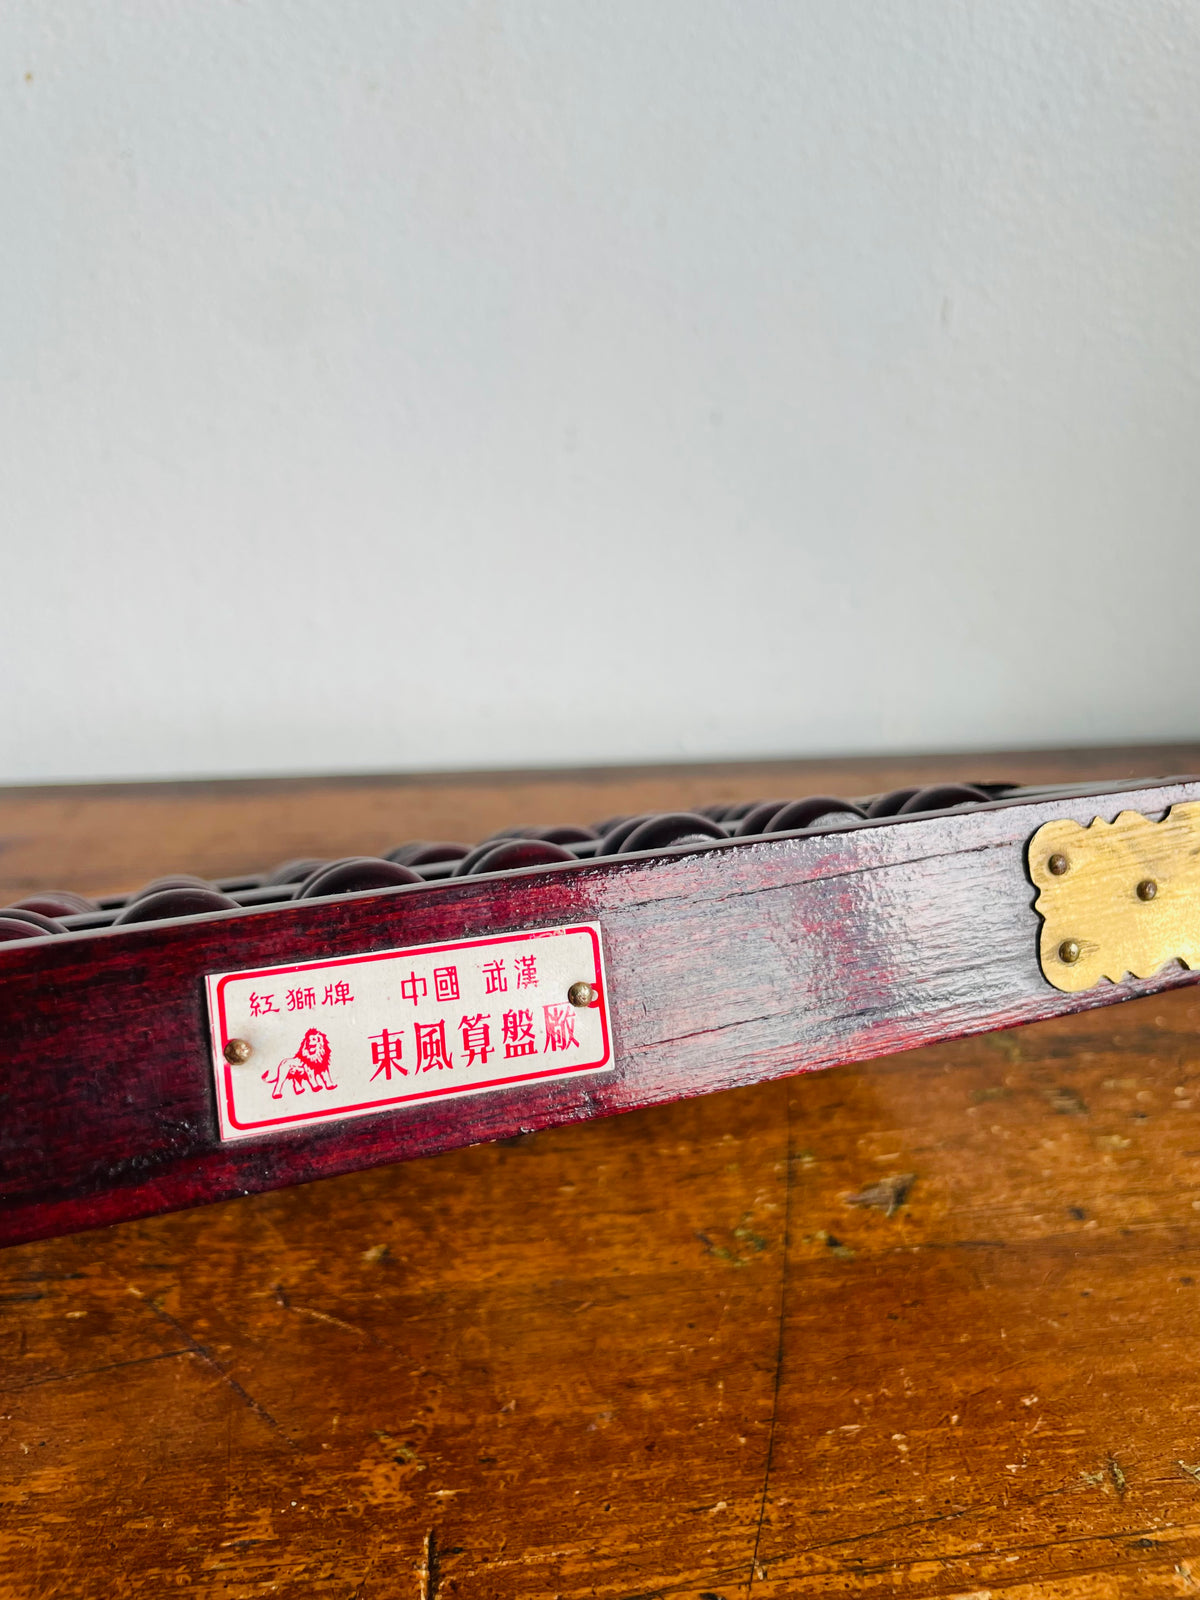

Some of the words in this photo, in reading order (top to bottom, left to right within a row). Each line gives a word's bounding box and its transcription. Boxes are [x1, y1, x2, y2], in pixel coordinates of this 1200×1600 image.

[249, 980, 354, 1017] 紅獅牌
[401, 966, 460, 1006] 中國
[482, 954, 540, 994] 武漢
